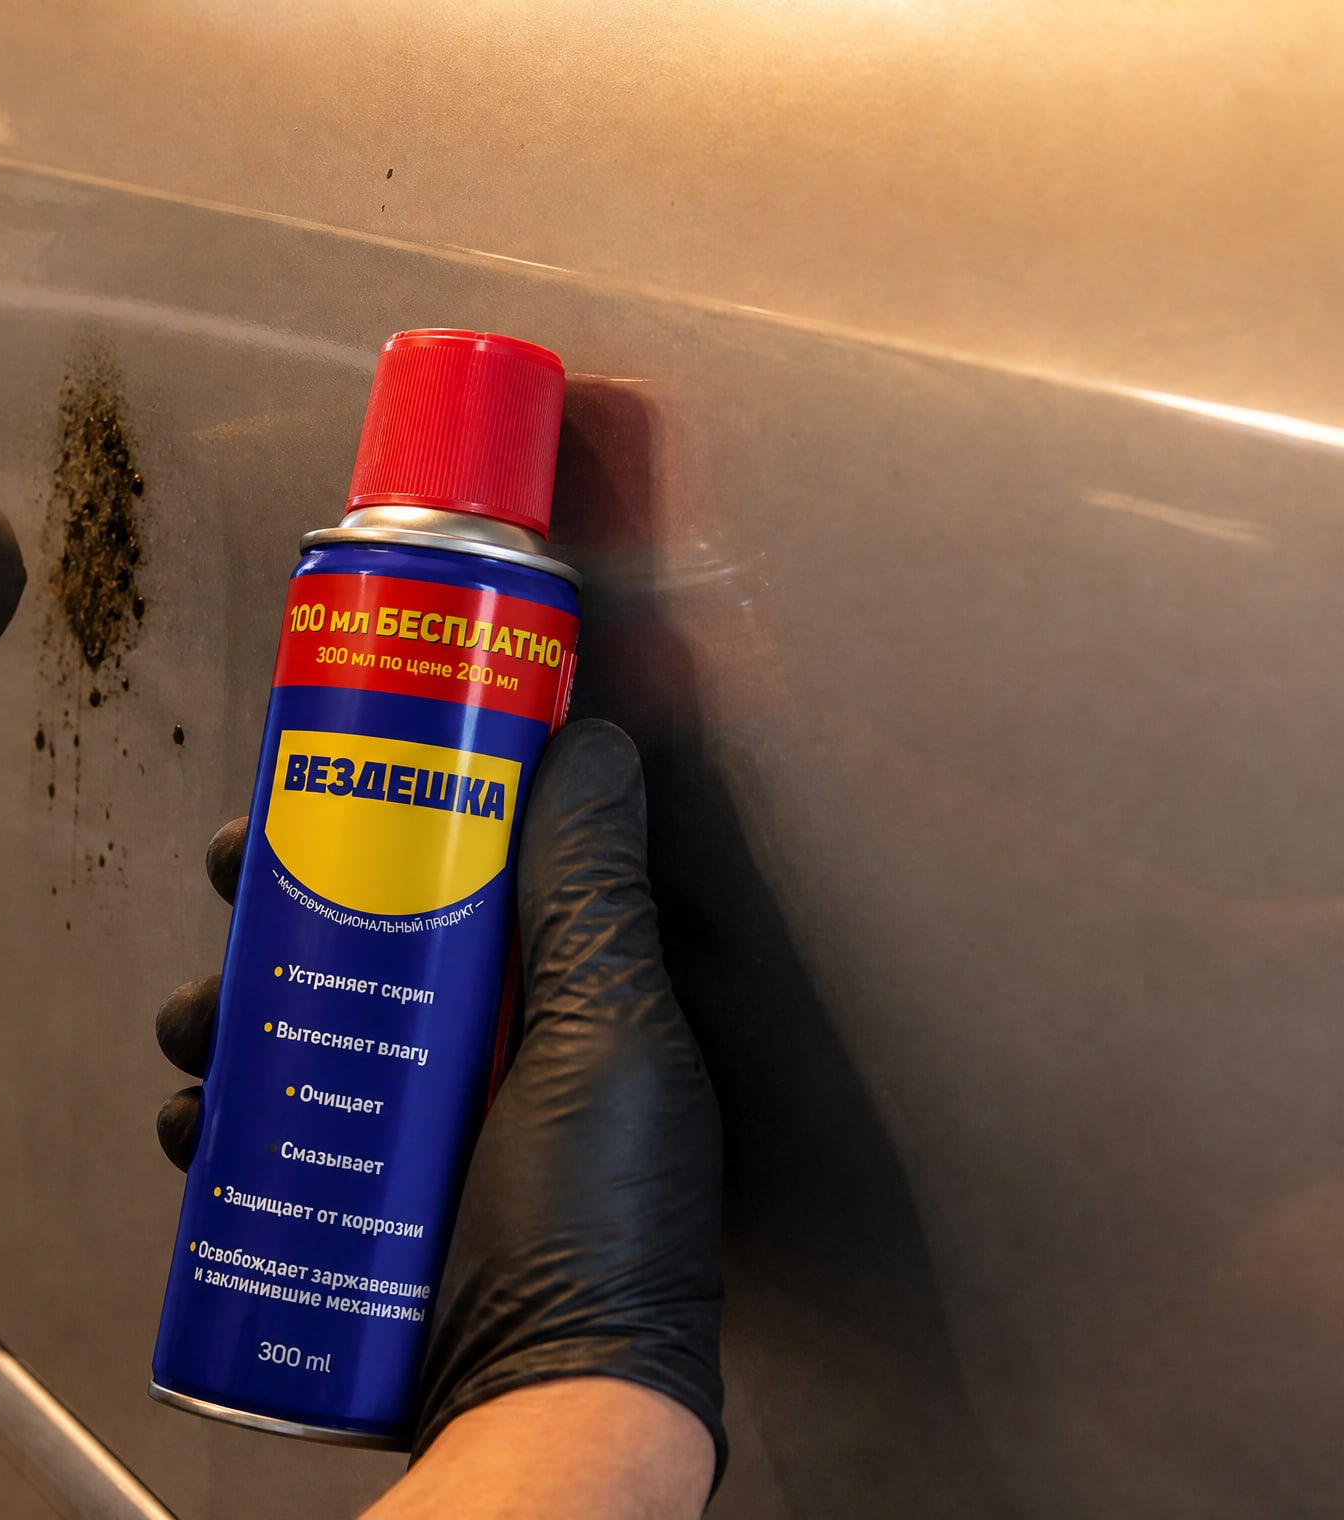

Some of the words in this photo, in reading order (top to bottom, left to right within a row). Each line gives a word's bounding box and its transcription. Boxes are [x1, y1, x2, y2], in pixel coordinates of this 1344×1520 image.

[291, 604, 326, 634] 100
[330, 611, 370, 634] мл
[375, 607, 562, 668] БЕСПЛАТНО
[316, 647, 348, 665] 300
[351, 653, 375, 667] мл
[379, 656, 402, 671] по
[406, 659, 453, 678] цене
[457, 663, 493, 686] 200
[496, 674, 519, 691] мл
[284, 754, 505, 821] ВЕЗДЕШКА
[288, 964, 378, 996] Устраняет
[381, 983, 435, 1005] скрип
[276, 1020, 375, 1053] Вытесняет
[377, 1041, 429, 1067] влагу
[299, 1084, 384, 1115] Очищает
[280, 1141, 384, 1175] Смазывает
[223, 1185, 314, 1220] Защищает
[316, 1209, 338, 1225] от
[341, 1213, 424, 1239] коррозии
[198, 1240, 309, 1280] Освобождает
[311, 1269, 431, 1299] заржавевшие
[194, 1266, 203, 1281] и
[205, 1270, 322, 1307] заклинившие
[326, 1294, 425, 1322] механизмы
[258, 1341, 301, 1367] 300
[305, 1353, 331, 1373] ml
